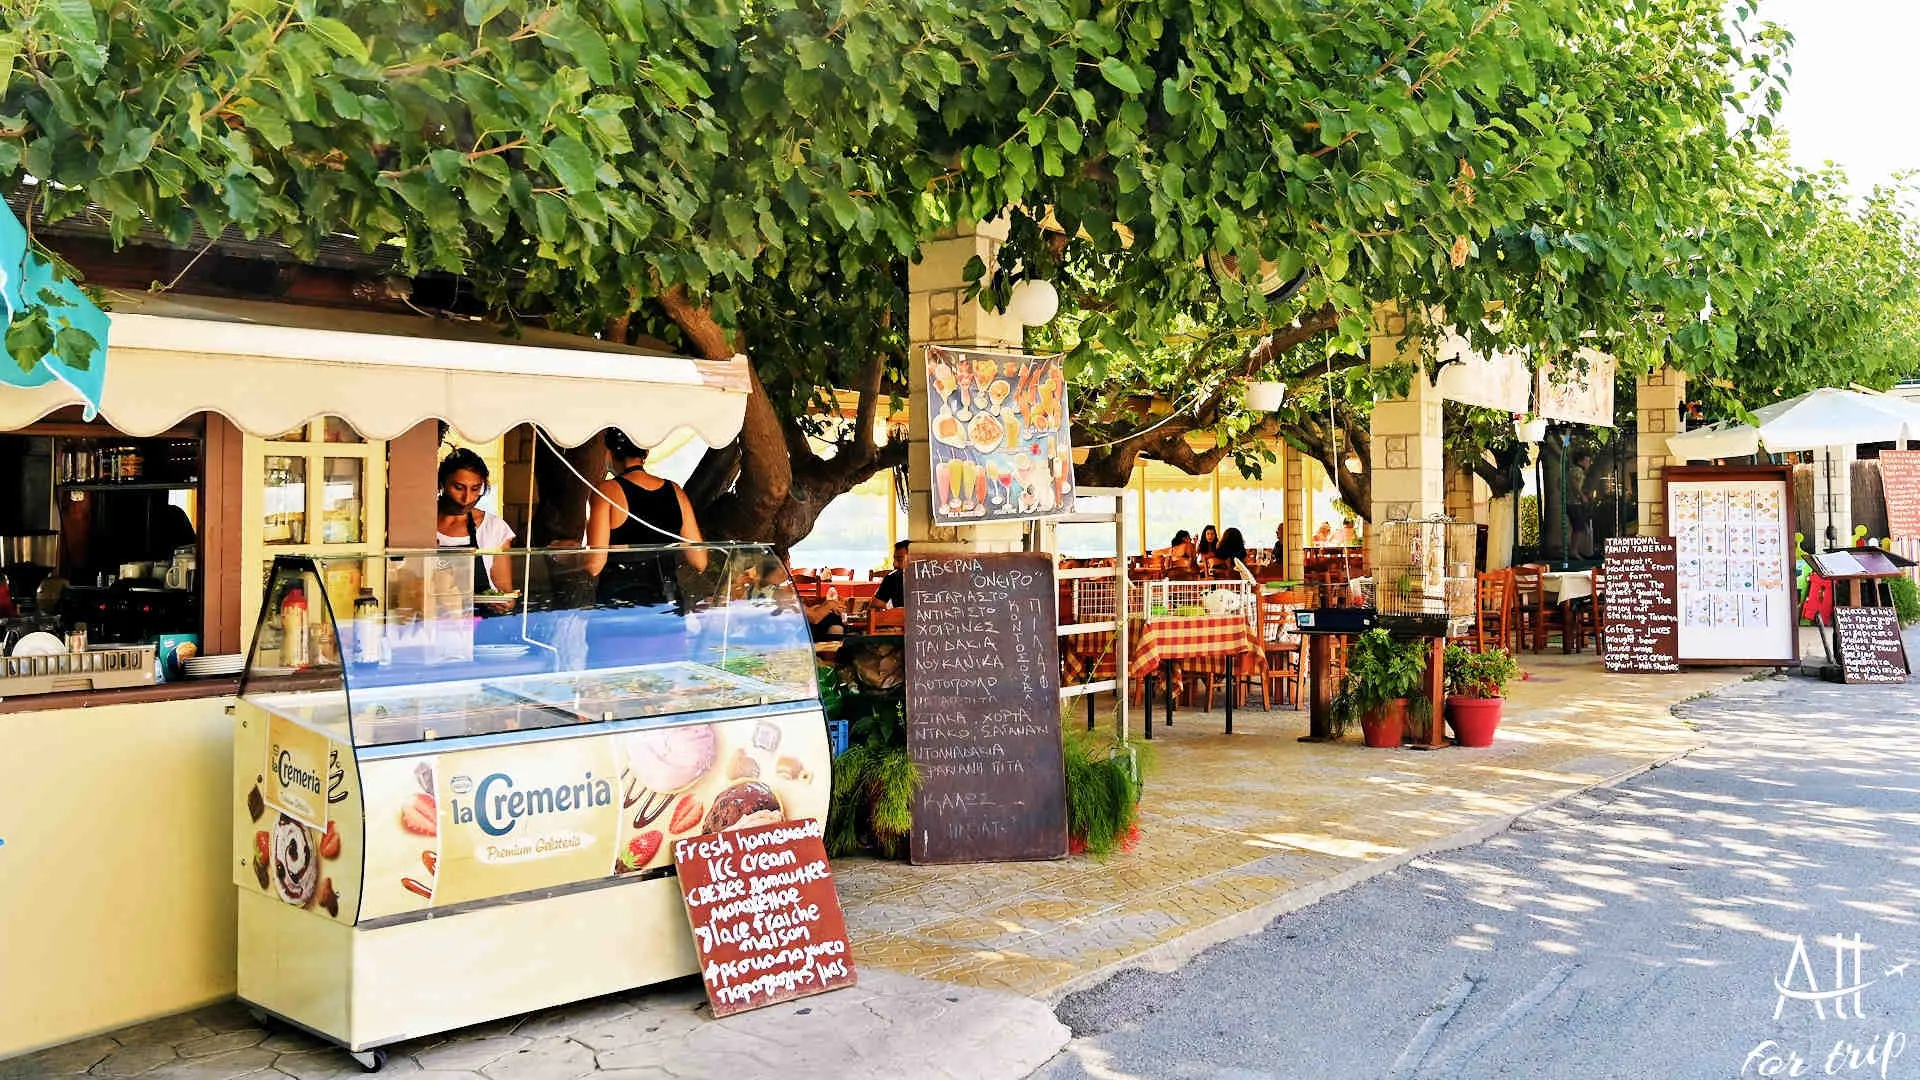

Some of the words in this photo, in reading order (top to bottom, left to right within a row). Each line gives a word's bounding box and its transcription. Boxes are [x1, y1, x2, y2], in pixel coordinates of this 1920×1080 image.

[1606, 537, 1660, 546] TRADITIONAL
[912, 559, 983, 580] ΤΑΒΕΡΝΑ
[1606, 564, 1647, 574] produced
[1624, 557, 1644, 565] meat
[1629, 572, 1652, 580] farm
[1632, 582, 1646, 590] you
[278, 750, 320, 795] Cremeria
[451, 798, 474, 825] la
[474, 771, 611, 836] Cremeria
[736, 820, 821, 850] homemade
[486, 844, 532, 860] Premium
[536, 837, 581, 853] Gelateria
[739, 926, 810, 952] maison
